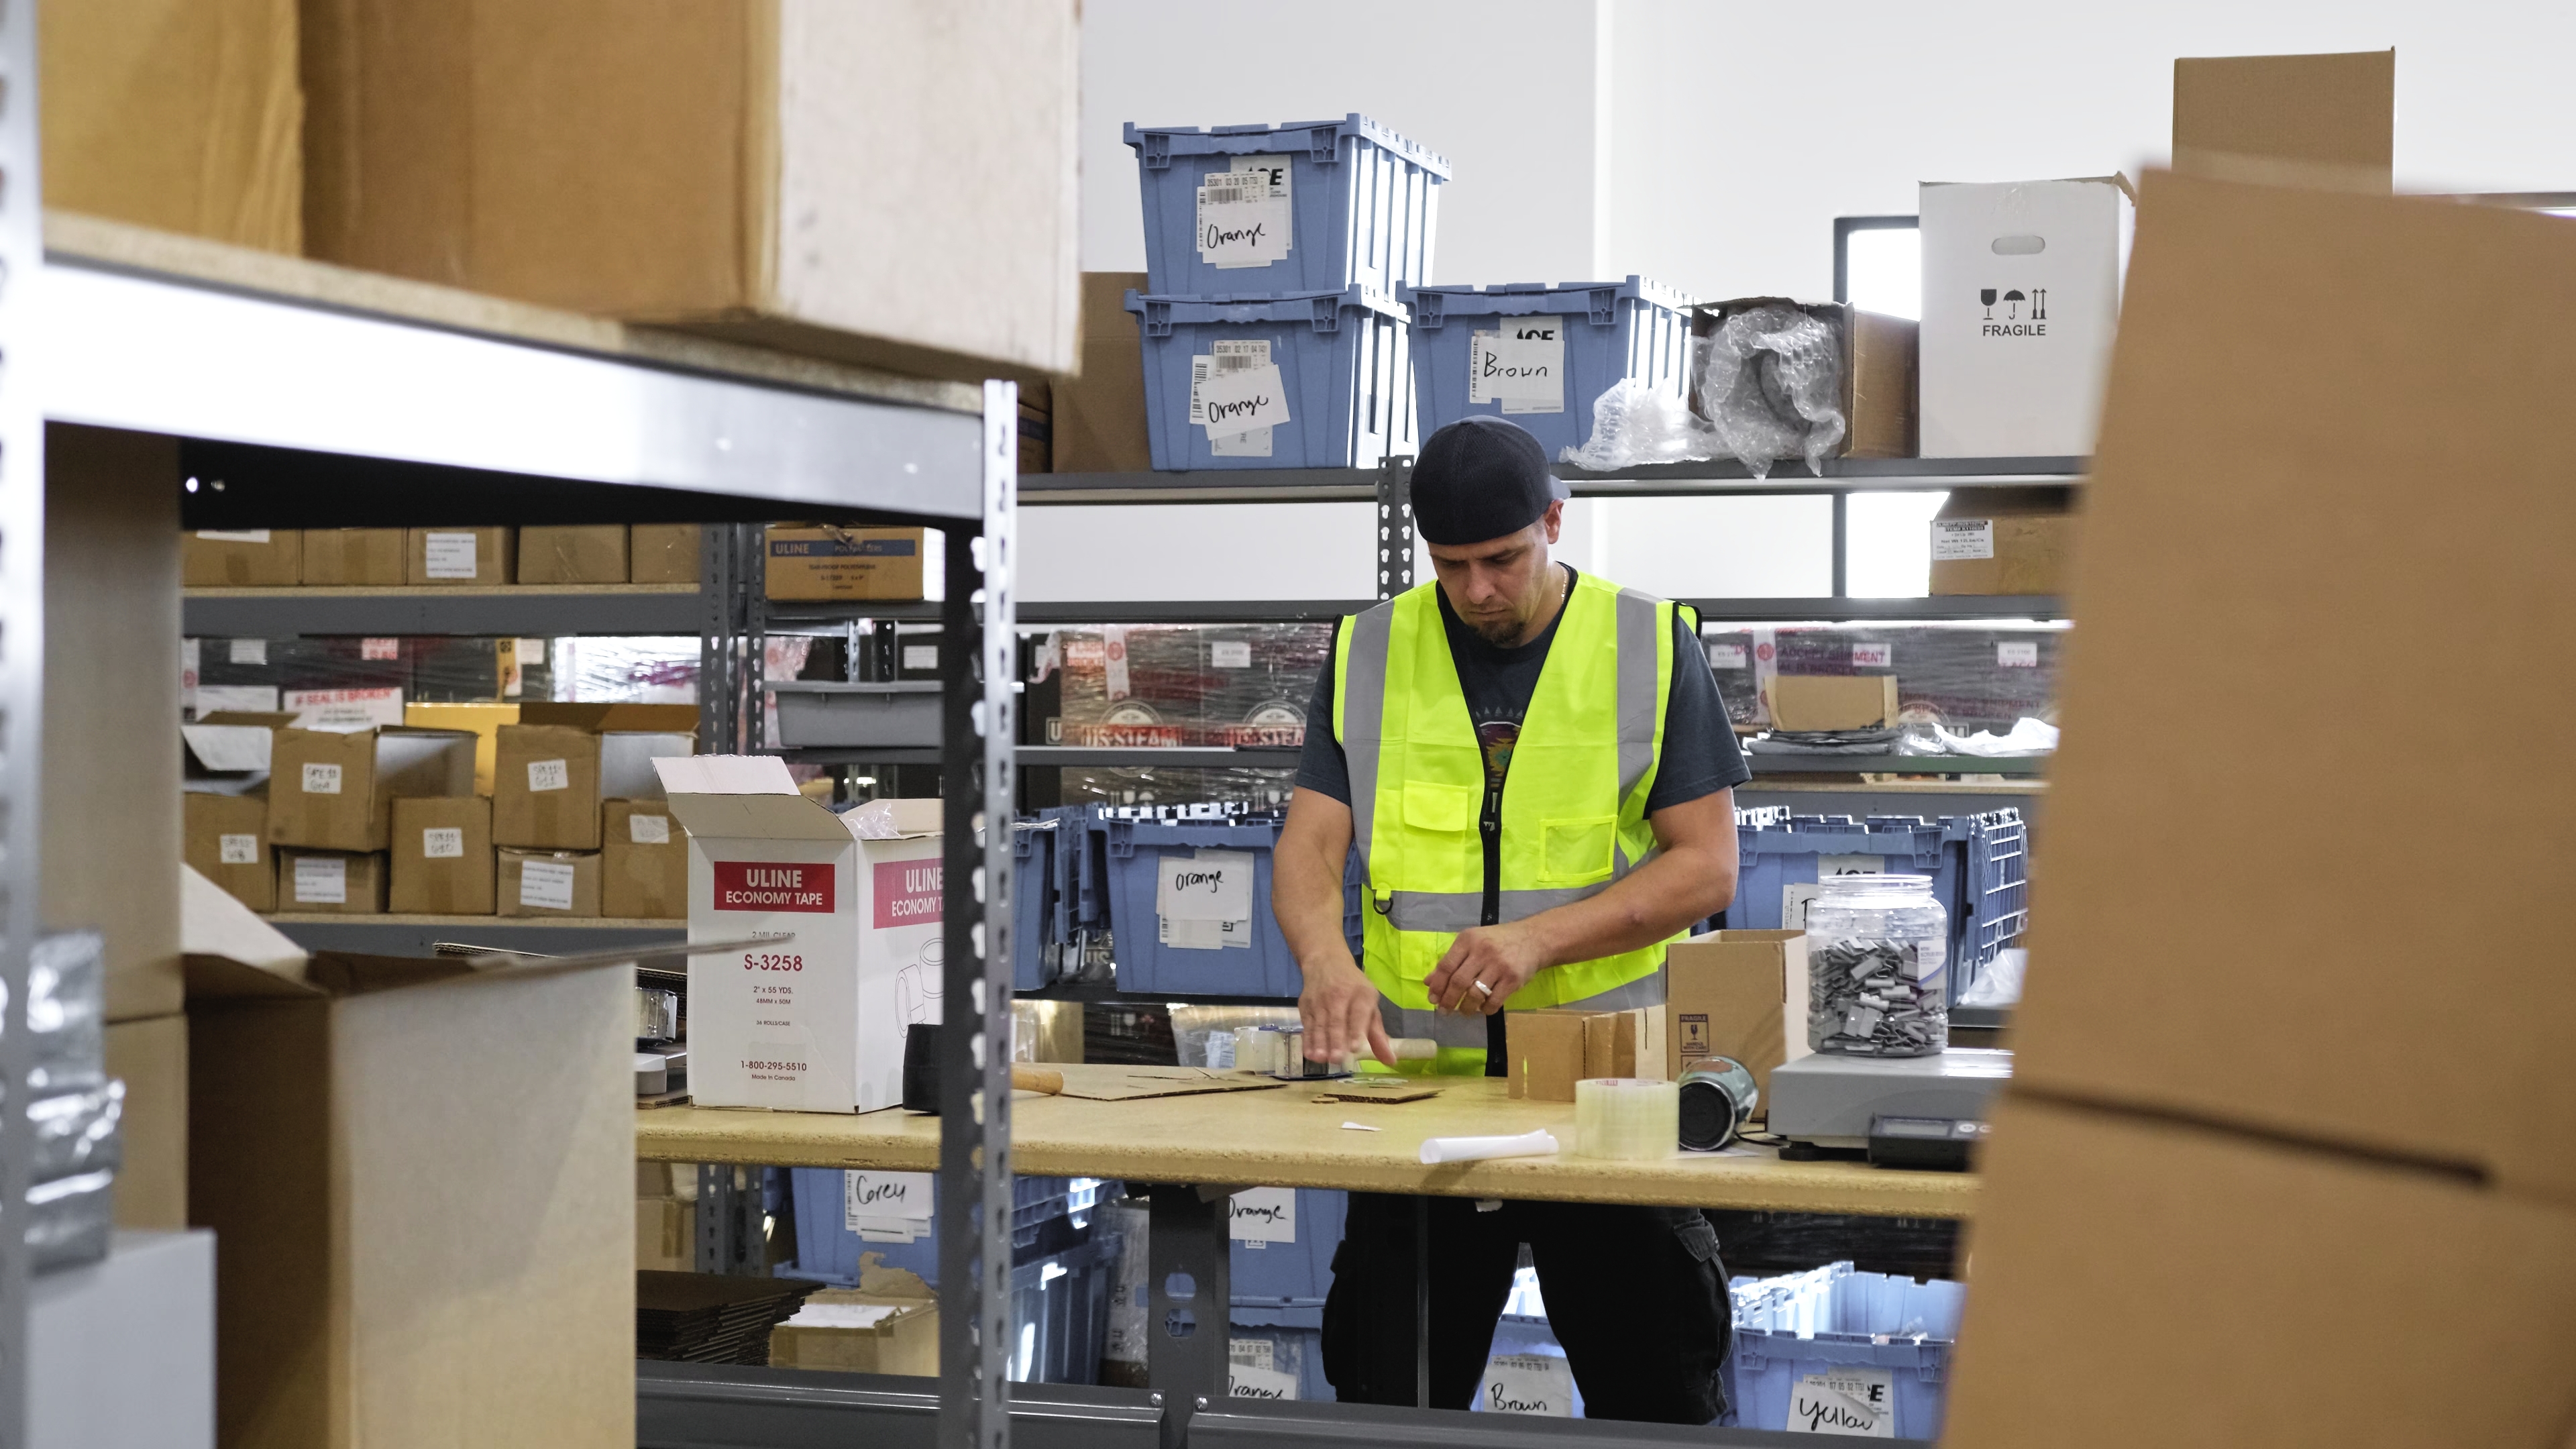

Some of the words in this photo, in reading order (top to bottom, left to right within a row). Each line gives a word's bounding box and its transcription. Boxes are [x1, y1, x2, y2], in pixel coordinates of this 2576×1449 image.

[1207, 222, 1267, 249] Orange
[1982, 324, 2047, 337] FRAGILE
[1483, 351, 1548, 378] Brown
[1208, 395, 1269, 423] Orange
[775, 543, 810, 554] ULINE
[746, 868, 802, 888] ULINE
[906, 867, 943, 894] ULINE
[726, 890, 792, 904] ECONOMY
[794, 892, 823, 906] TAPE
[892, 896, 936, 917] ECONOMY
[744, 953, 803, 972] S-3258
[767, 986, 777, 994] 55
[741, 1060, 807, 1071] 1-800-295-5510
[1491, 1383, 1548, 1411] Brown
